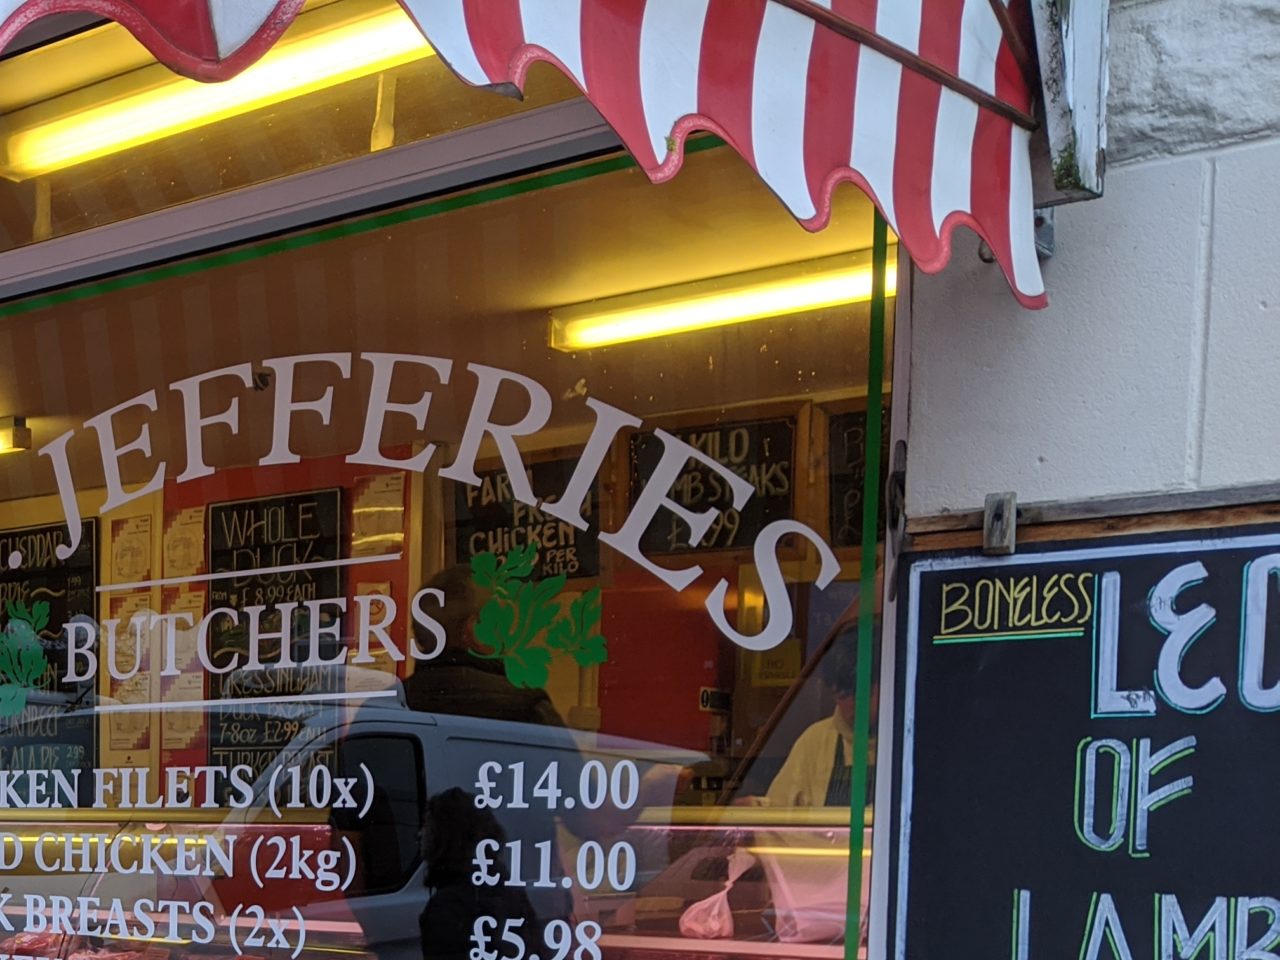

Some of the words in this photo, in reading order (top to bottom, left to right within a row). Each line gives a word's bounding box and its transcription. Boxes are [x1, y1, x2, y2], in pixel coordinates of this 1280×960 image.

[39, 352, 841, 651] JEFFERIES
[221, 502, 320, 548] WHOLE
[233, 541, 314, 588] DUCK
[546, 547, 577, 563] PER
[941, 572, 1093, 634] BONELESS
[62, 588, 446, 682] BUTCHERS
[93, 765, 254, 808] FILETS
[269, 762, 375, 818] (10x)
[474, 760, 639, 809] £14.00
[1074, 735, 1196, 857] OF
[35, 834, 234, 877] CHICKEN
[250, 835, 357, 891] (2kg)
[472, 839, 636, 891] £11.00
[24, 895, 215, 944] BREASTS
[230, 903, 307, 959] (2x)
